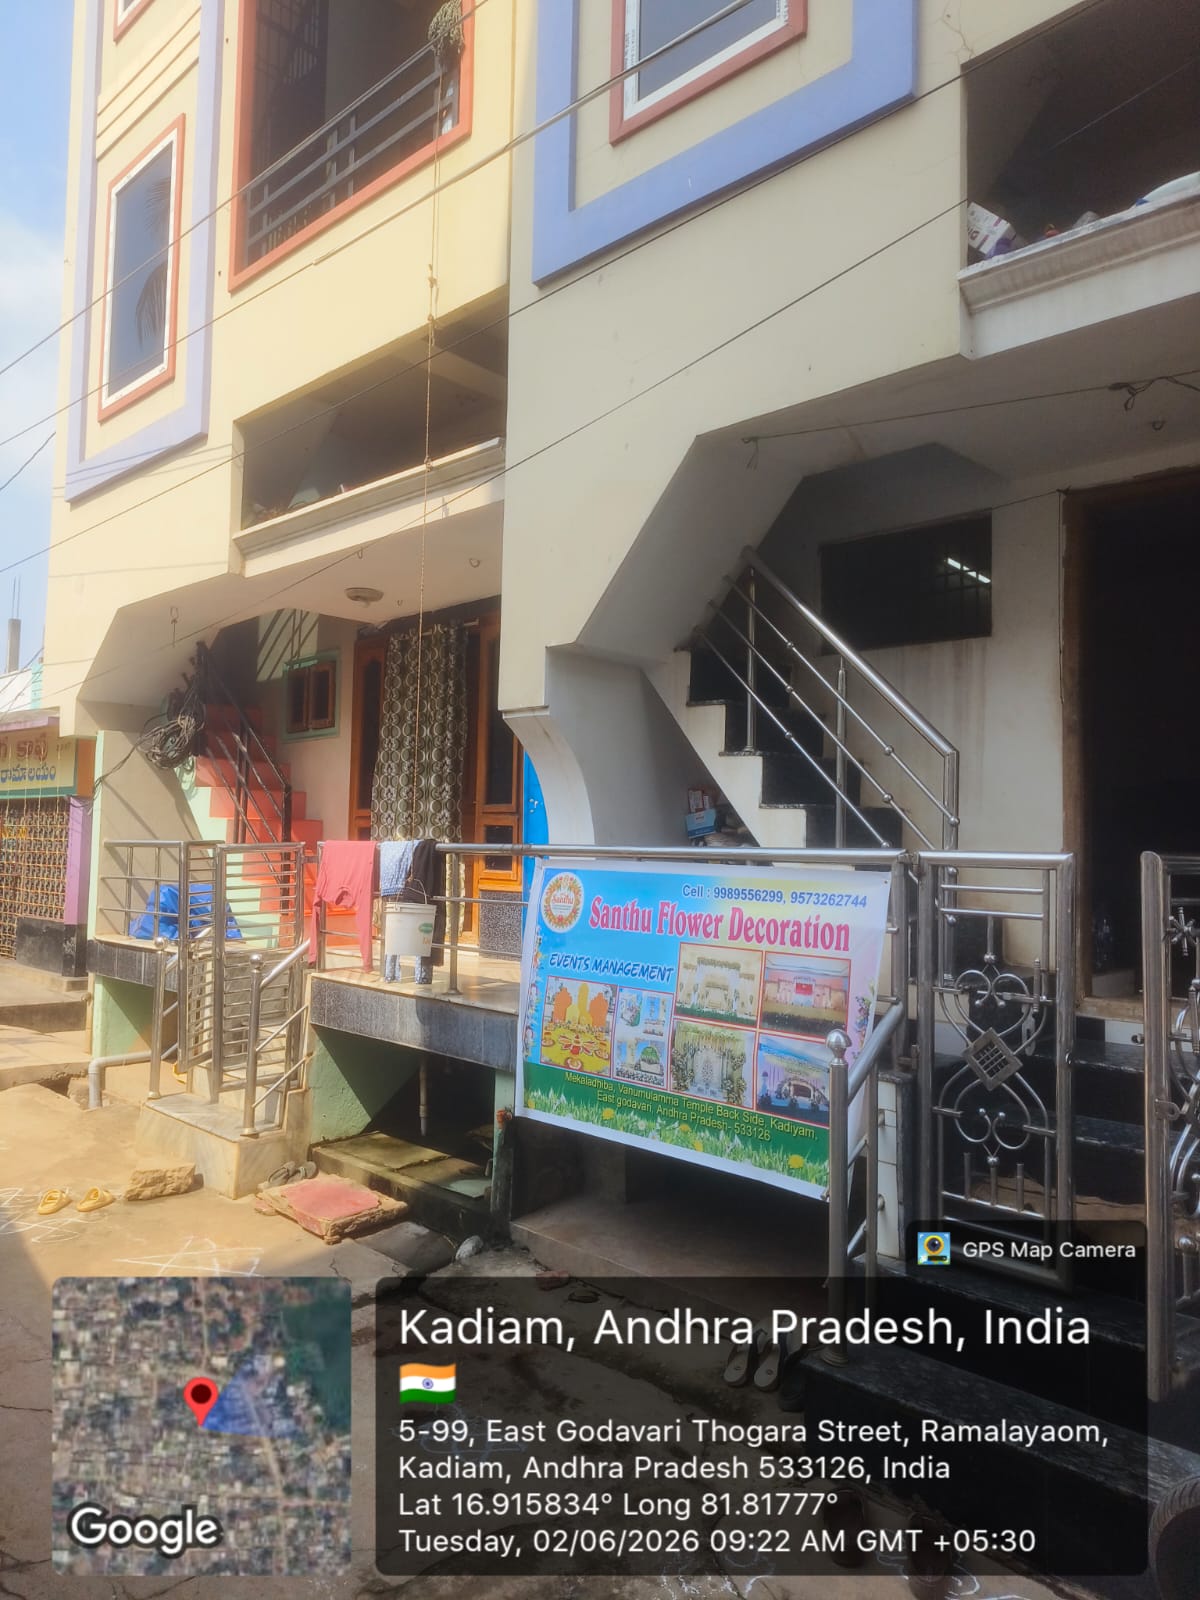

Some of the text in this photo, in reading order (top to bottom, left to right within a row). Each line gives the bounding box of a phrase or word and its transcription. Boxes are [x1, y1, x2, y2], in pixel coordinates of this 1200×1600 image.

[682, 884, 704, 897] Cell
[713, 886, 786, 905] 9989556299,
[790, 890, 868, 908] 9573262744
[588, 896, 851, 951] Santhu Flower Decoration
[549, 953, 675, 983] EVENTS MANAGEMENT
[597, 1090, 615, 1104] East
[656, 1105, 688, 1121] Andhra
[690, 1112, 732, 1132] Pradesh-
[734, 1122, 771, 1141] 533126
[682, 1098, 714, 1114] Temple
[716, 1105, 740, 1120] Back
[742, 1112, 767, 1128] Side,
[770, 1118, 818, 1140] Kadiyam,
